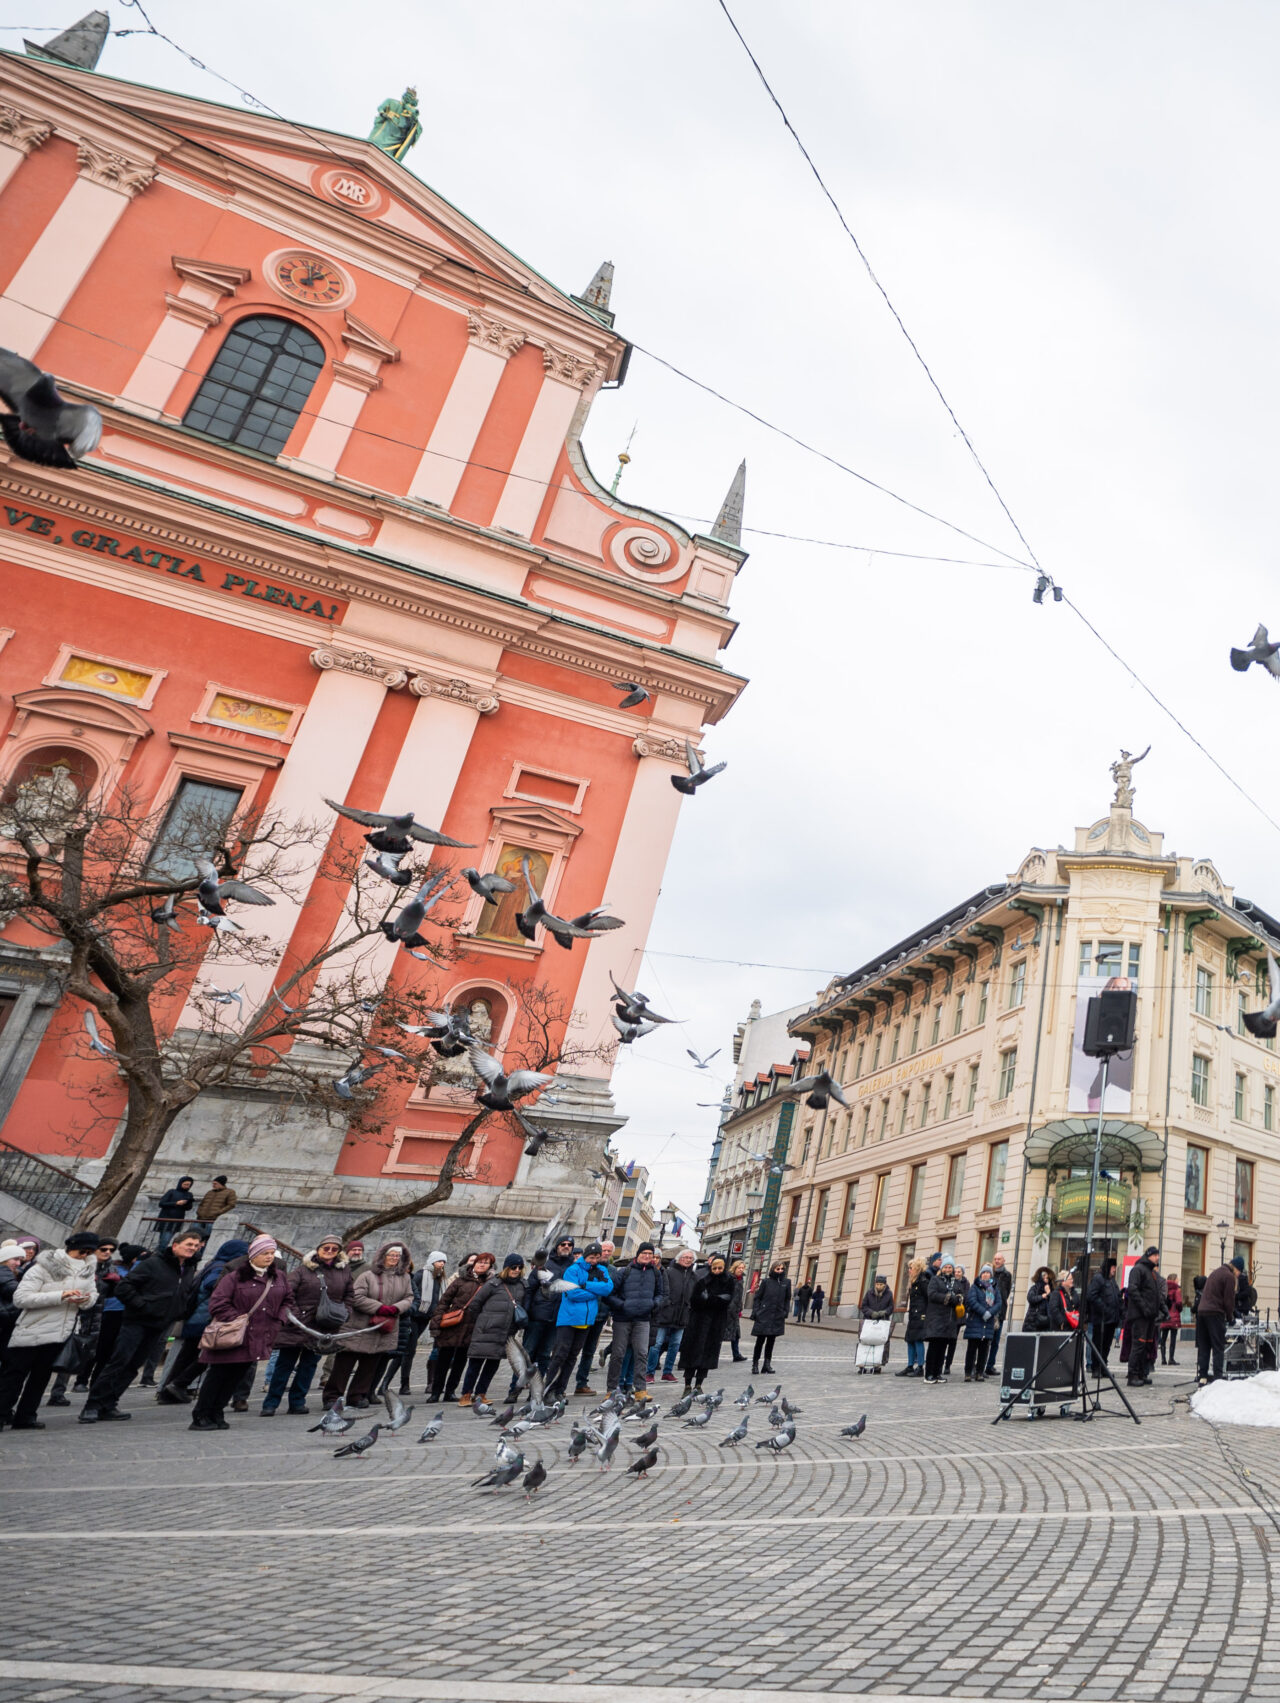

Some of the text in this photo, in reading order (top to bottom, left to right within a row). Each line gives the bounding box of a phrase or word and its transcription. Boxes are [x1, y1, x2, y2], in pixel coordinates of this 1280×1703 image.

[72, 529, 205, 582] GRATIA
[221, 573, 338, 620] PLENA!
[859, 1050, 943, 1097] GALERIJA EMPORIUM
[759, 1109, 792, 1242] GALERIJA EPORIUM
